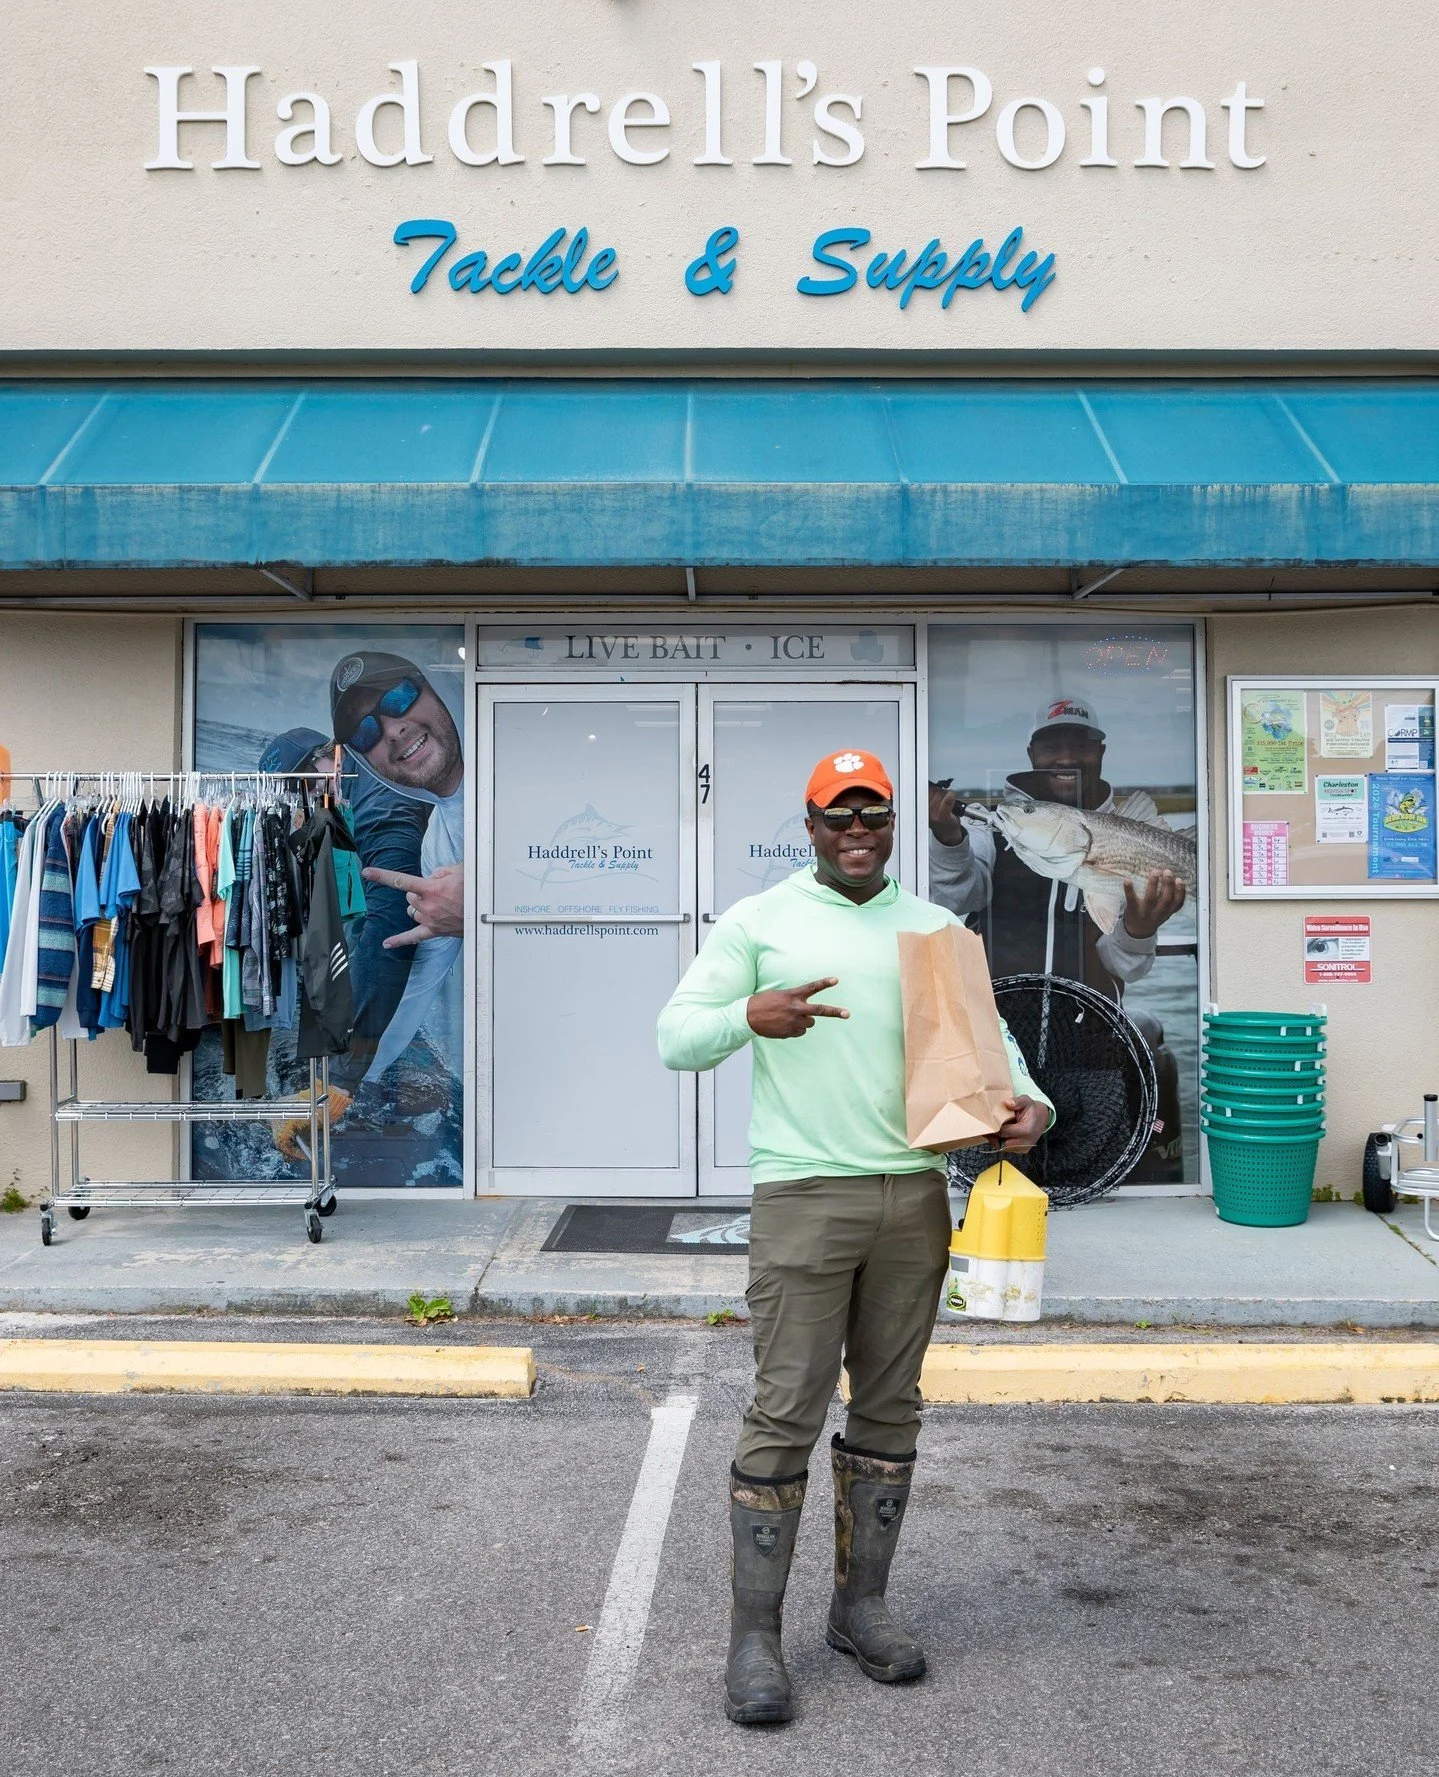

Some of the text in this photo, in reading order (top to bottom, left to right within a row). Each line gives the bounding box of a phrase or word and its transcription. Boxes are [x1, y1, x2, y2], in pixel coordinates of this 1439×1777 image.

[144, 59, 1267, 171] Haddrell's Point
[393, 219, 1057, 313] Tackle & Supply
[565, 635, 825, 660] LIVE BAIT ICE
[1084, 645, 1168, 668] OPEN
[1372, 783, 1381, 874] 2024 Tournament
[528, 845, 653, 859] Haddrell's Point
[568, 860, 639, 871] Tackle & Supply
[514, 905, 659, 913] INSHORE OFFSHORE FLY FISHING
[515, 924, 659, 938] www.haddrellspoint.com
[1317, 963, 1357, 971] SONITROL
